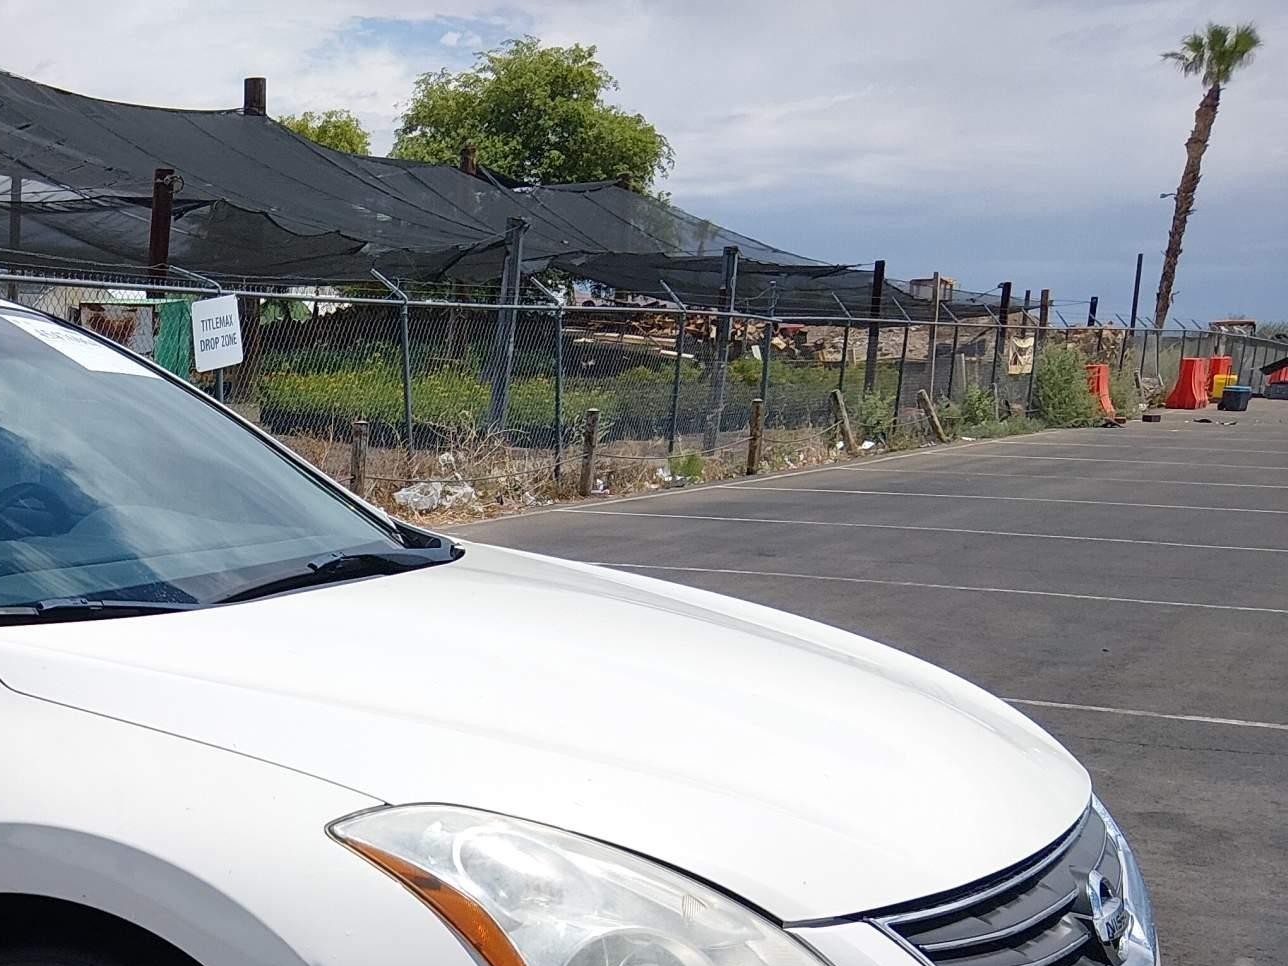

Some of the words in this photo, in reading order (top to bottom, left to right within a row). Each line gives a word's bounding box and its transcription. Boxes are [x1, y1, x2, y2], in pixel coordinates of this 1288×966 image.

[200, 314, 233, 332] TITLEMAX
[200, 337, 220, 352] DROP
[221, 332, 238, 348] ZONE
